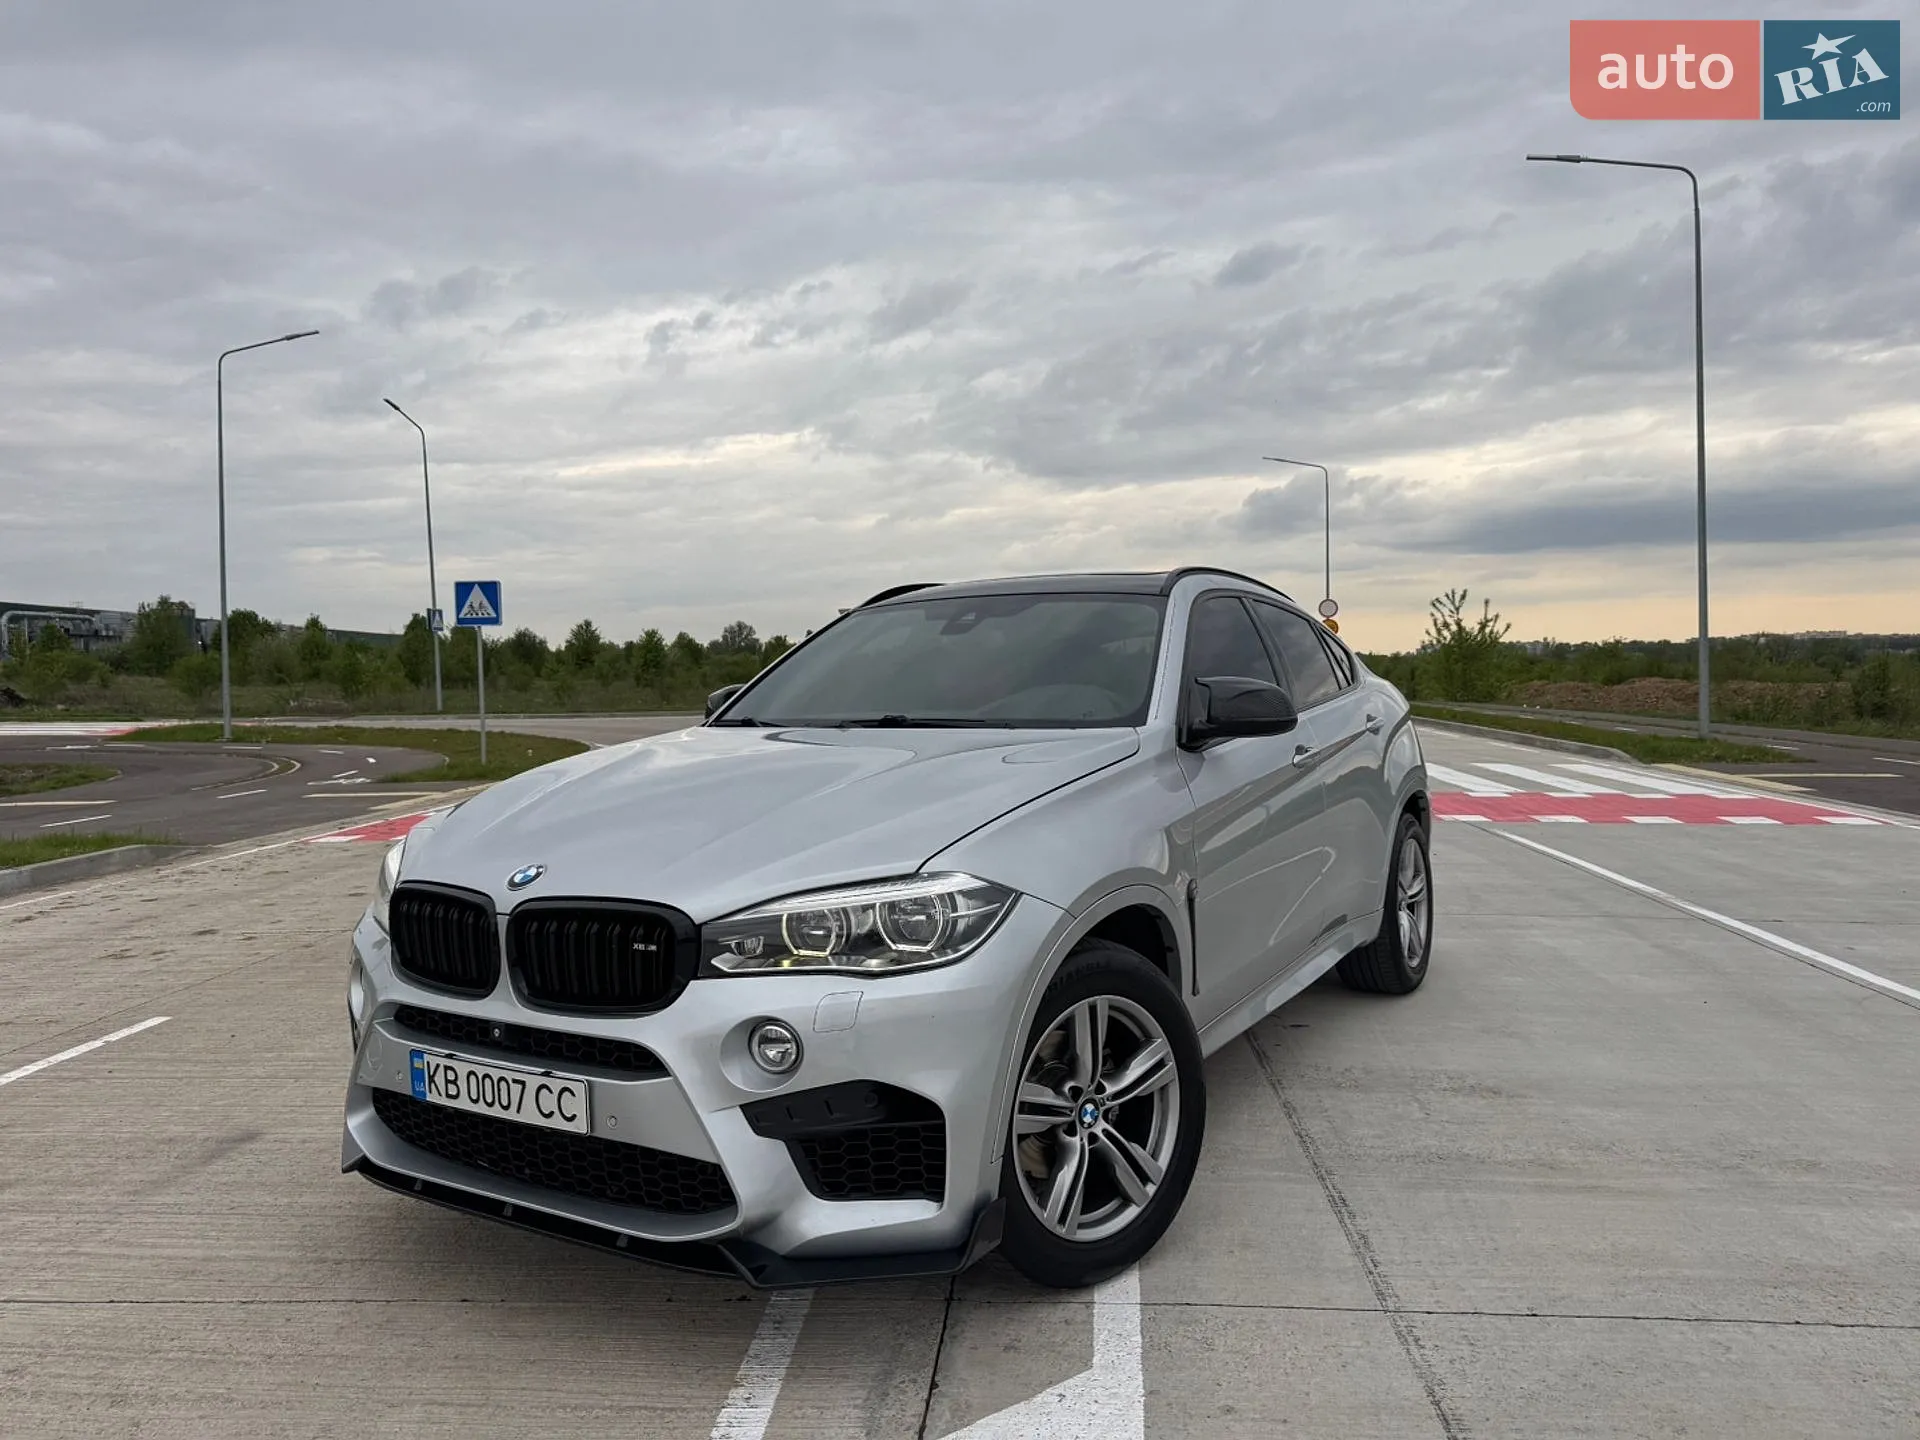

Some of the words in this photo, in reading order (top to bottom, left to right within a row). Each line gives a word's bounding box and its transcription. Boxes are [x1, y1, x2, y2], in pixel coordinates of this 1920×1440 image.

[426, 1060, 460, 1100] KB
[466, 1070, 527, 1114] 0007
[535, 1083, 577, 1123] CC
